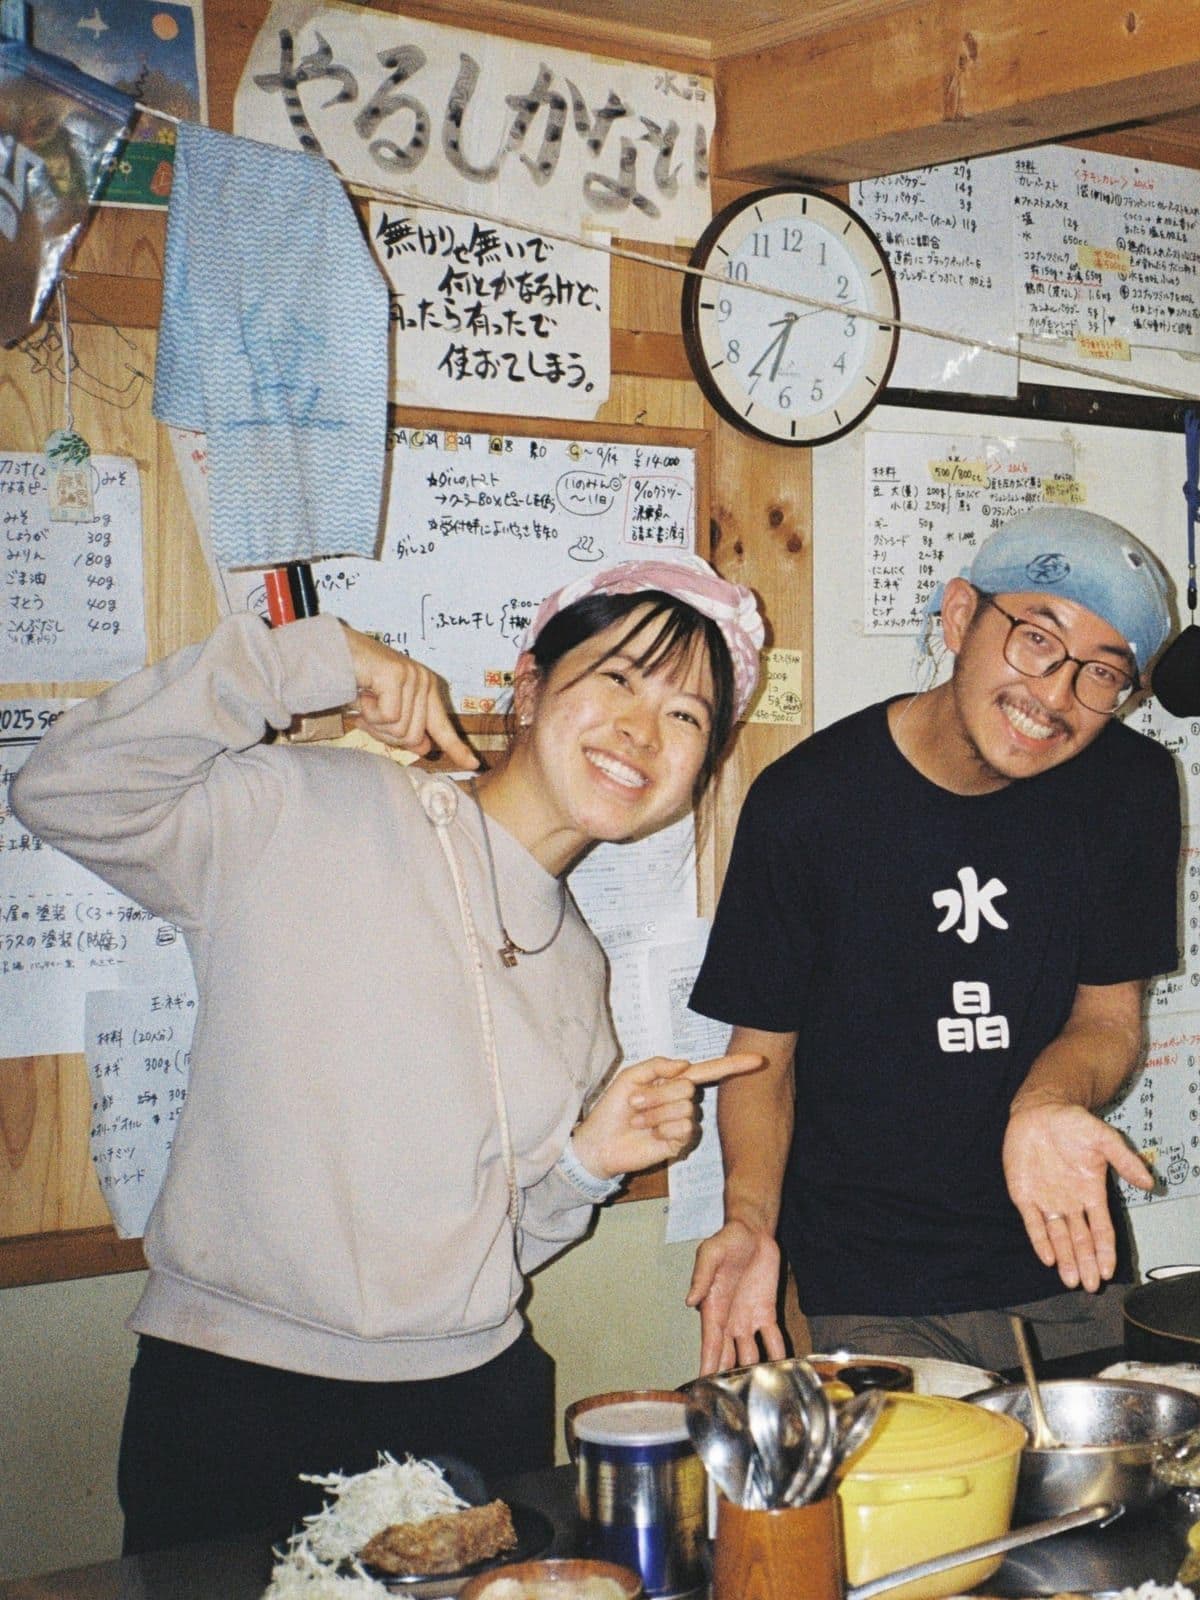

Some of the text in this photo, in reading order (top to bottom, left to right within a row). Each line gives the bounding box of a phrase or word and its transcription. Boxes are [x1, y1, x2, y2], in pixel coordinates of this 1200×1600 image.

[655, 72, 705, 101] 水晶
[253, 29, 708, 219] やるしかない
[376, 212, 554, 266] 無けりゃ無いで
[752, 233, 770, 258] 11
[782, 228, 803, 252] 12
[819, 243, 826, 266] 1
[728, 261, 747, 282] 10
[837, 276, 848, 299] 2
[718, 300, 732, 322] 9
[844, 315, 856, 338] 3
[727, 340, 740, 363] 8
[833, 352, 846, 375] 4
[749, 373, 762, 396] 7
[811, 379, 823, 401] 5
[779, 386, 792, 409] 6
[872, 466, 896, 477] 材料
[7, 528, 111, 547] しょうが 30g
[7, 549, 45, 562] みりん
[6, 570, 115, 590] ごま油 40g
[10, 594, 117, 612] さとう 40g
[873, 594, 896, 603] トマト
[8, 619, 120, 635] こんぶだし 40g
[0, 709, 34, 731] 025
[932, 866, 1010, 1053] 水晶
